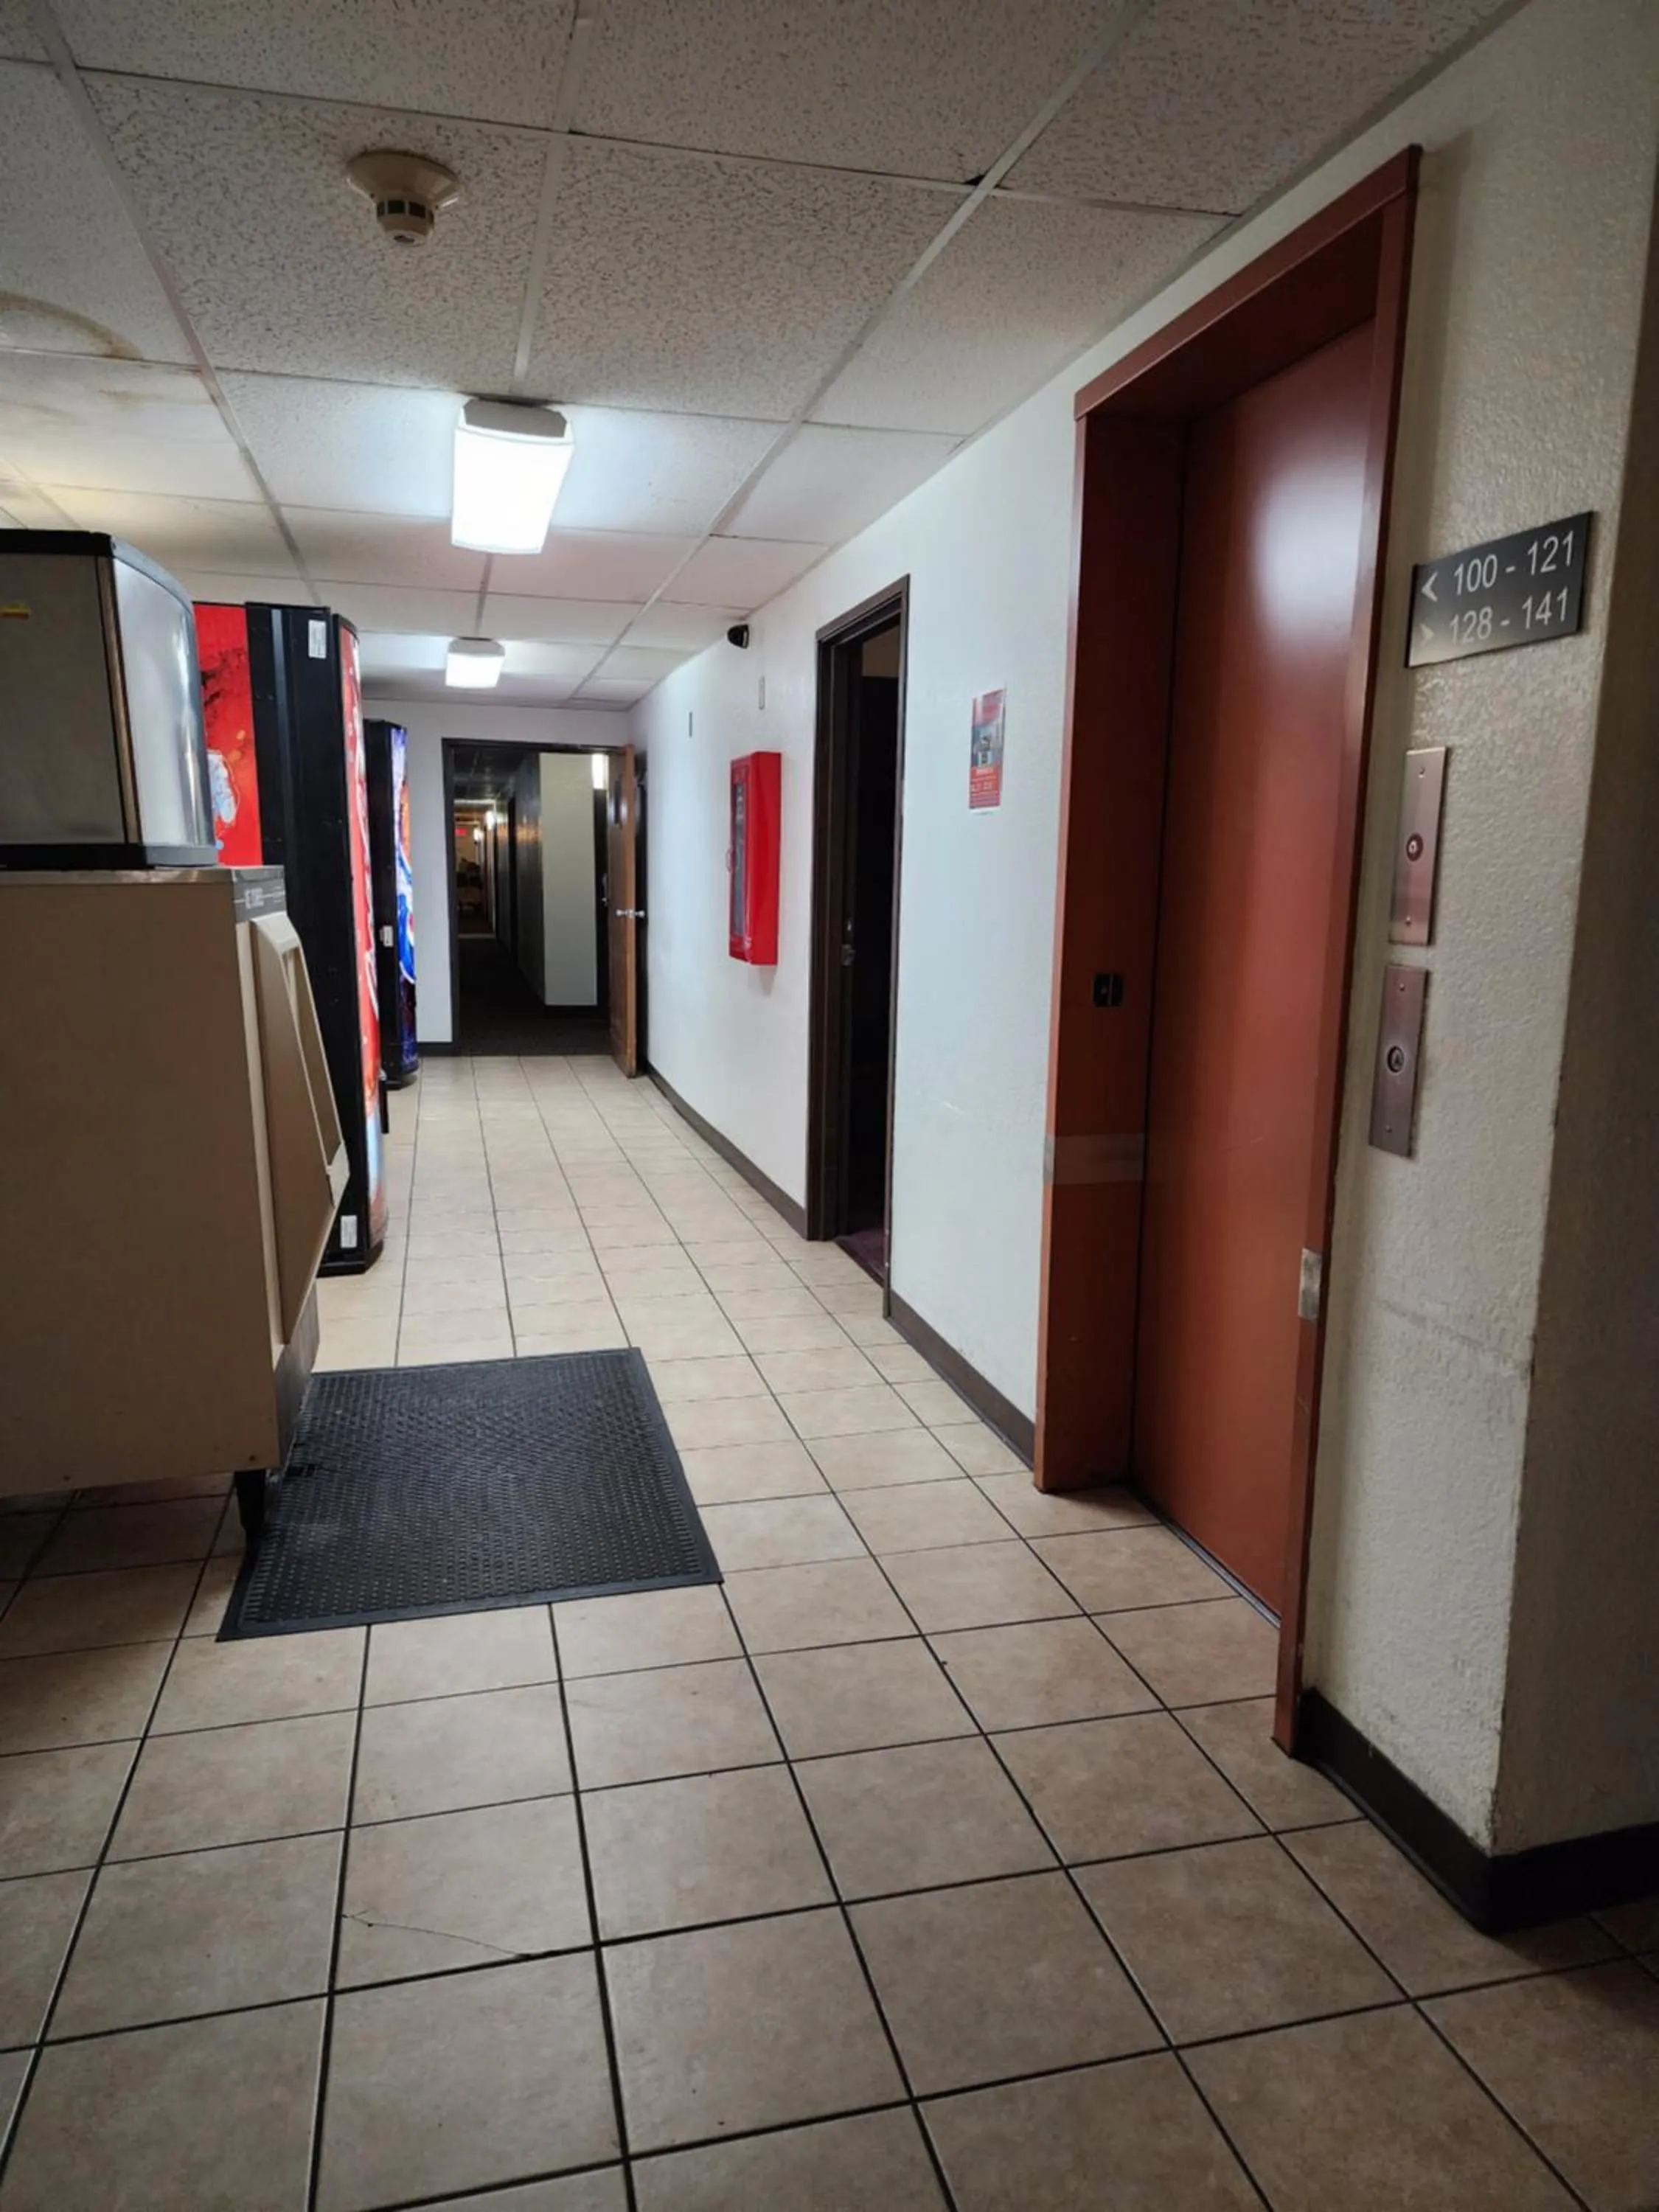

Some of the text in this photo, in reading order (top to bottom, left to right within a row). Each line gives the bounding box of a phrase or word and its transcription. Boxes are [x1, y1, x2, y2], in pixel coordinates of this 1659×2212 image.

[1453, 554, 1498, 596] 100
[1527, 530, 1574, 576] 121
[1449, 606, 1493, 645] 128
[1522, 586, 1569, 630] 141
